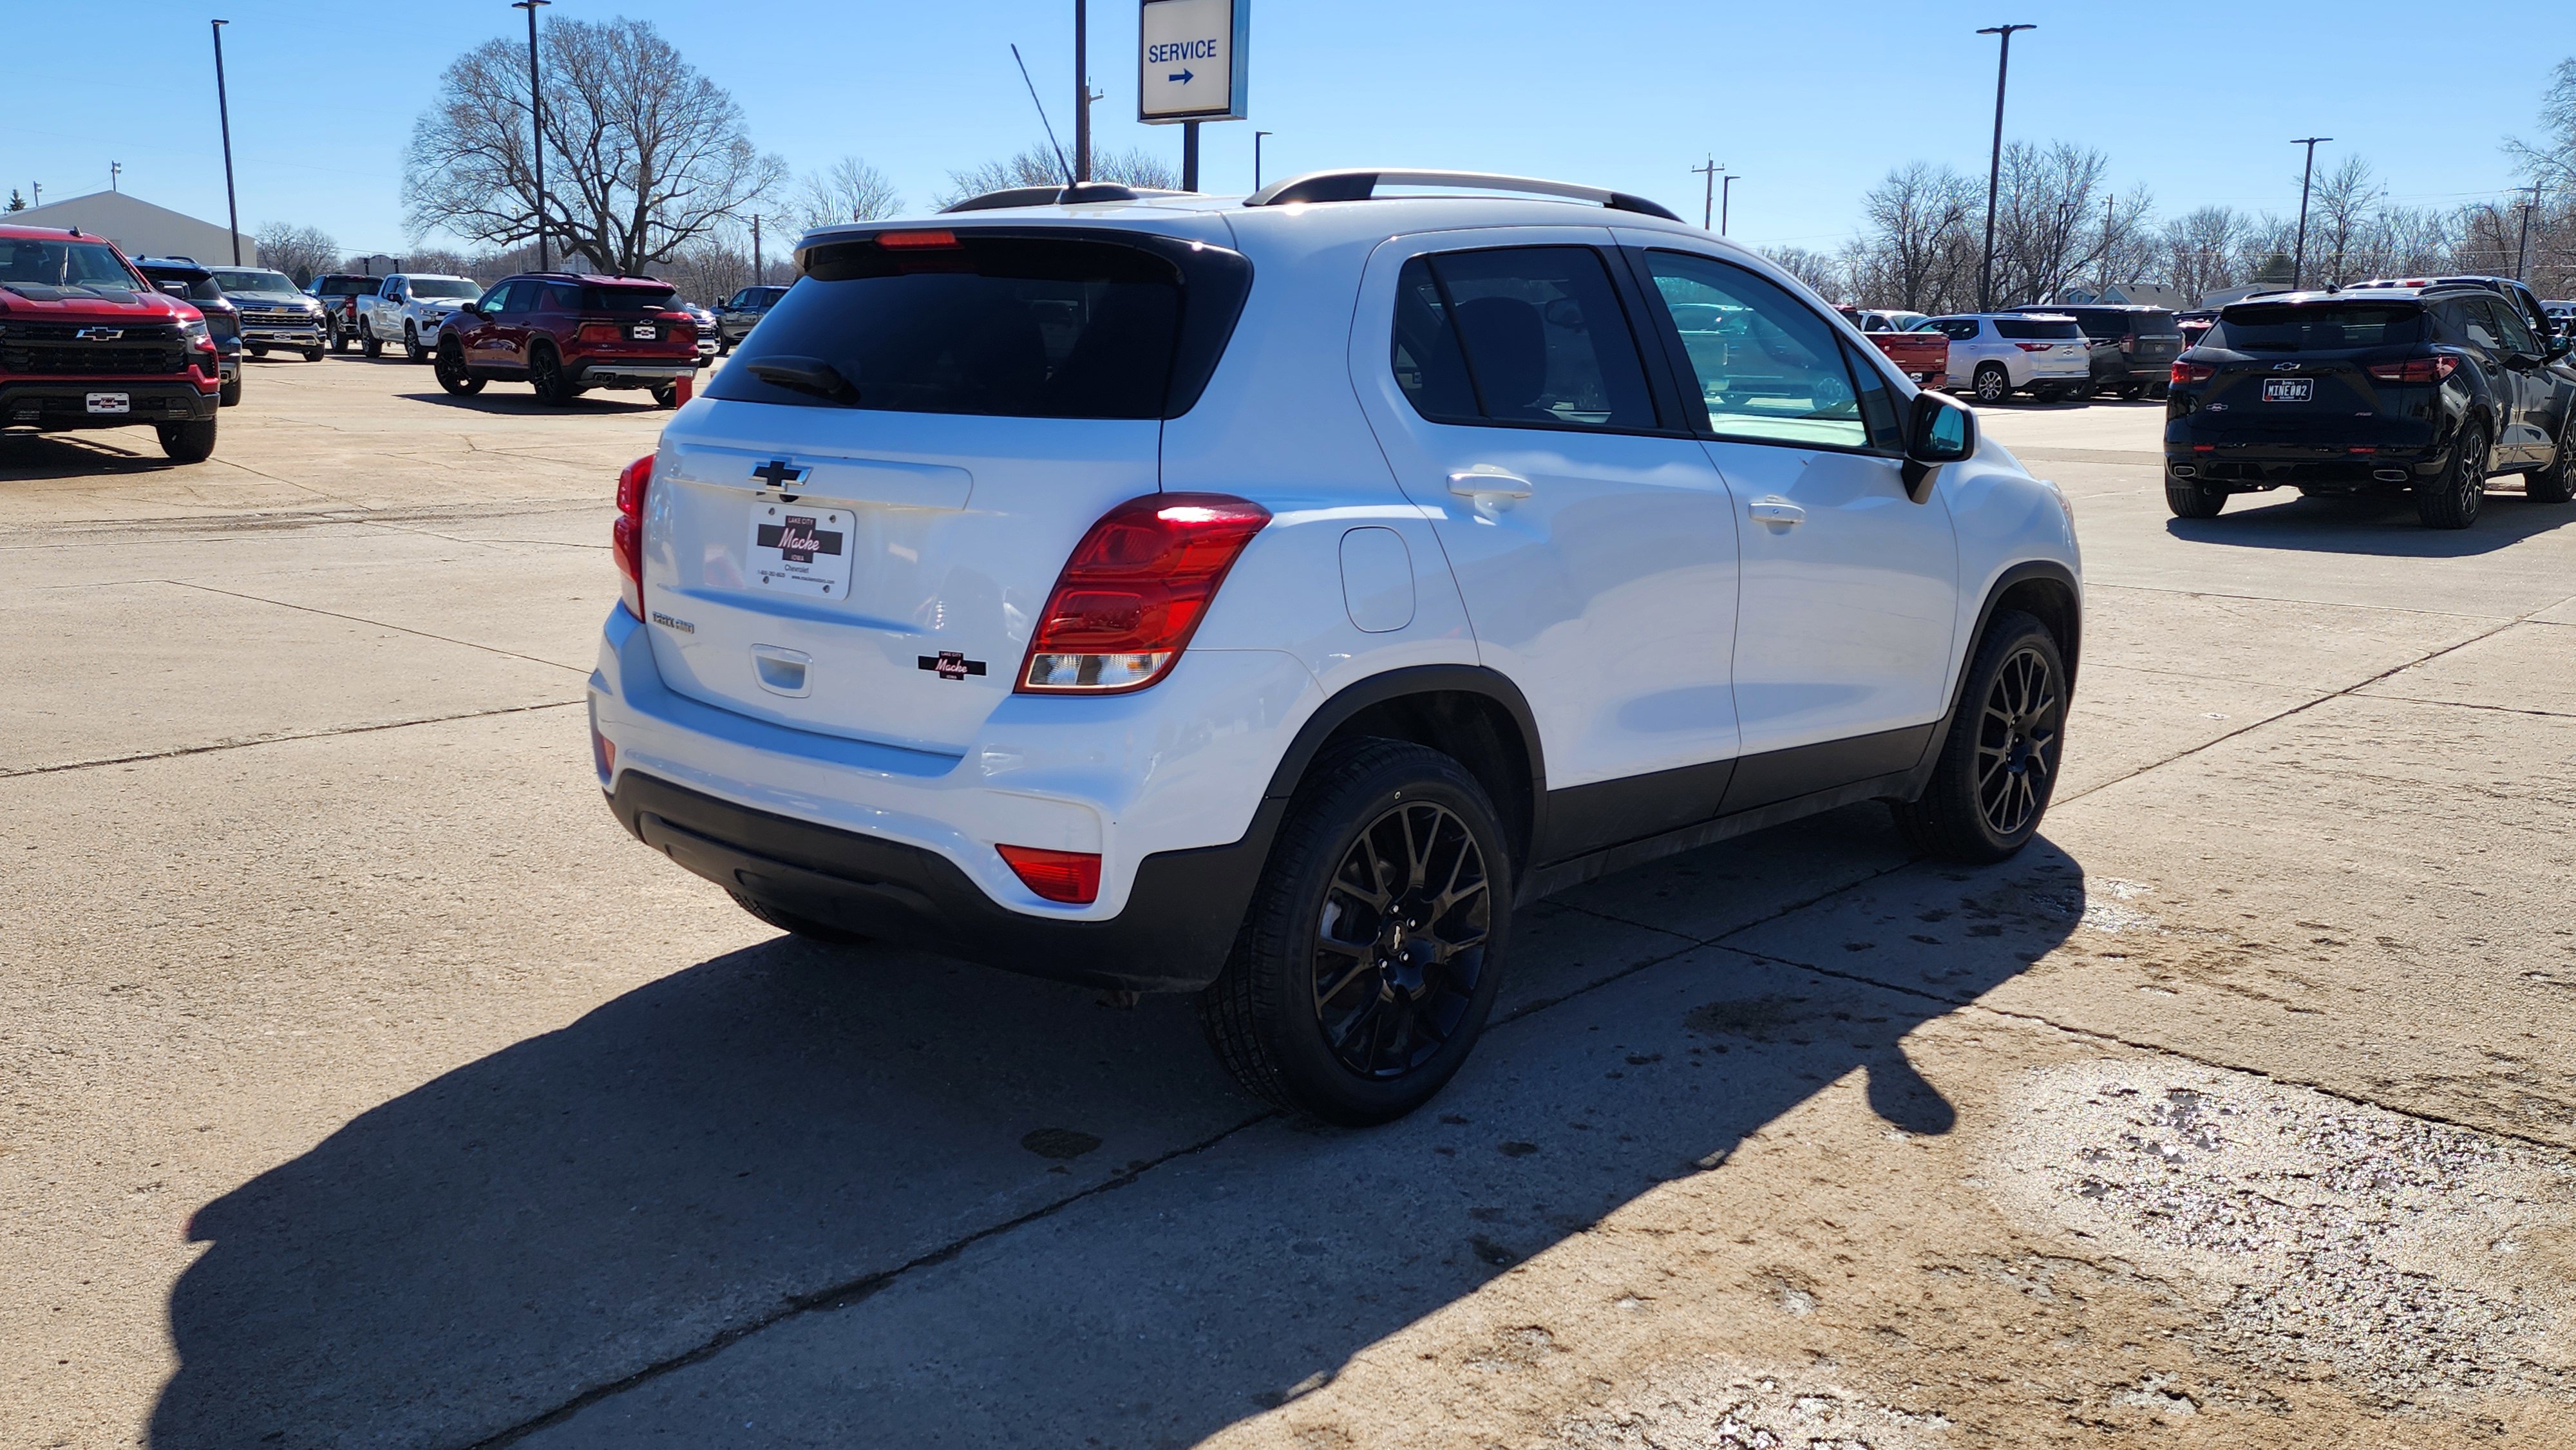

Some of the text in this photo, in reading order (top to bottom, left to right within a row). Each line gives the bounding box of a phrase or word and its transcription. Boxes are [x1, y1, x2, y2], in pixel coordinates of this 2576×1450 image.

[1148, 39, 1217, 64] SERVICE
[777, 527, 820, 551] Macke
[784, 564, 810, 574] Chevrolet
[934, 658, 968, 673] Macke
